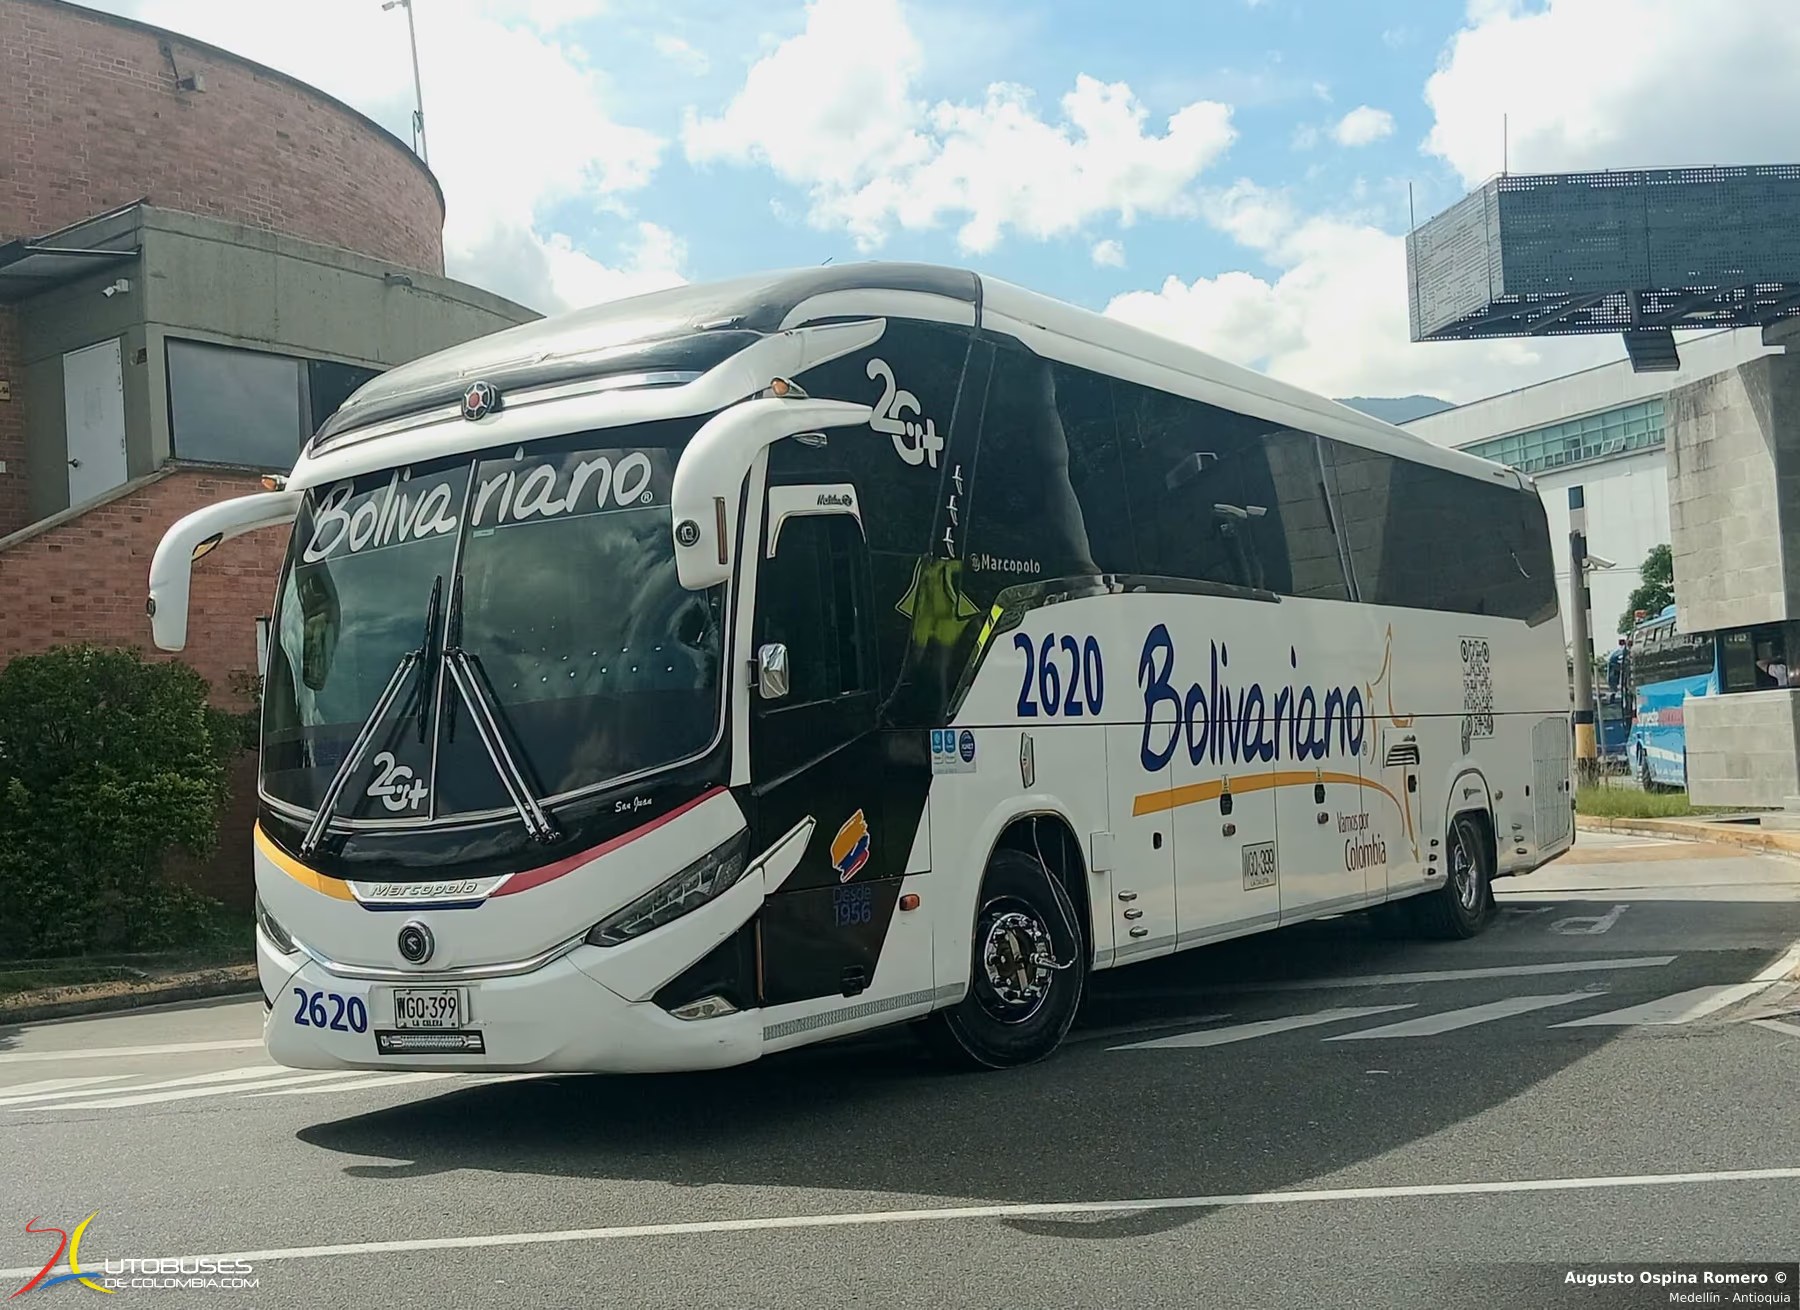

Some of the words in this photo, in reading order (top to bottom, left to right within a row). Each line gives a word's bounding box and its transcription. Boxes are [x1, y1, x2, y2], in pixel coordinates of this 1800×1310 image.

[303, 446, 653, 563] Bolivariano
[1013, 632, 1104, 718] 2620
[1138, 623, 1364, 772] Bolivariano
[615, 801, 631, 812] San
[1336, 811, 1358, 833] Vamos
[1358, 812, 1369, 836] por
[1344, 833, 1386, 872] Colombia
[370, 881, 478, 897] Marcopolo
[833, 884, 871, 904] Desde
[833, 901, 871, 928] 1956
[293, 987, 369, 1034] 2620
